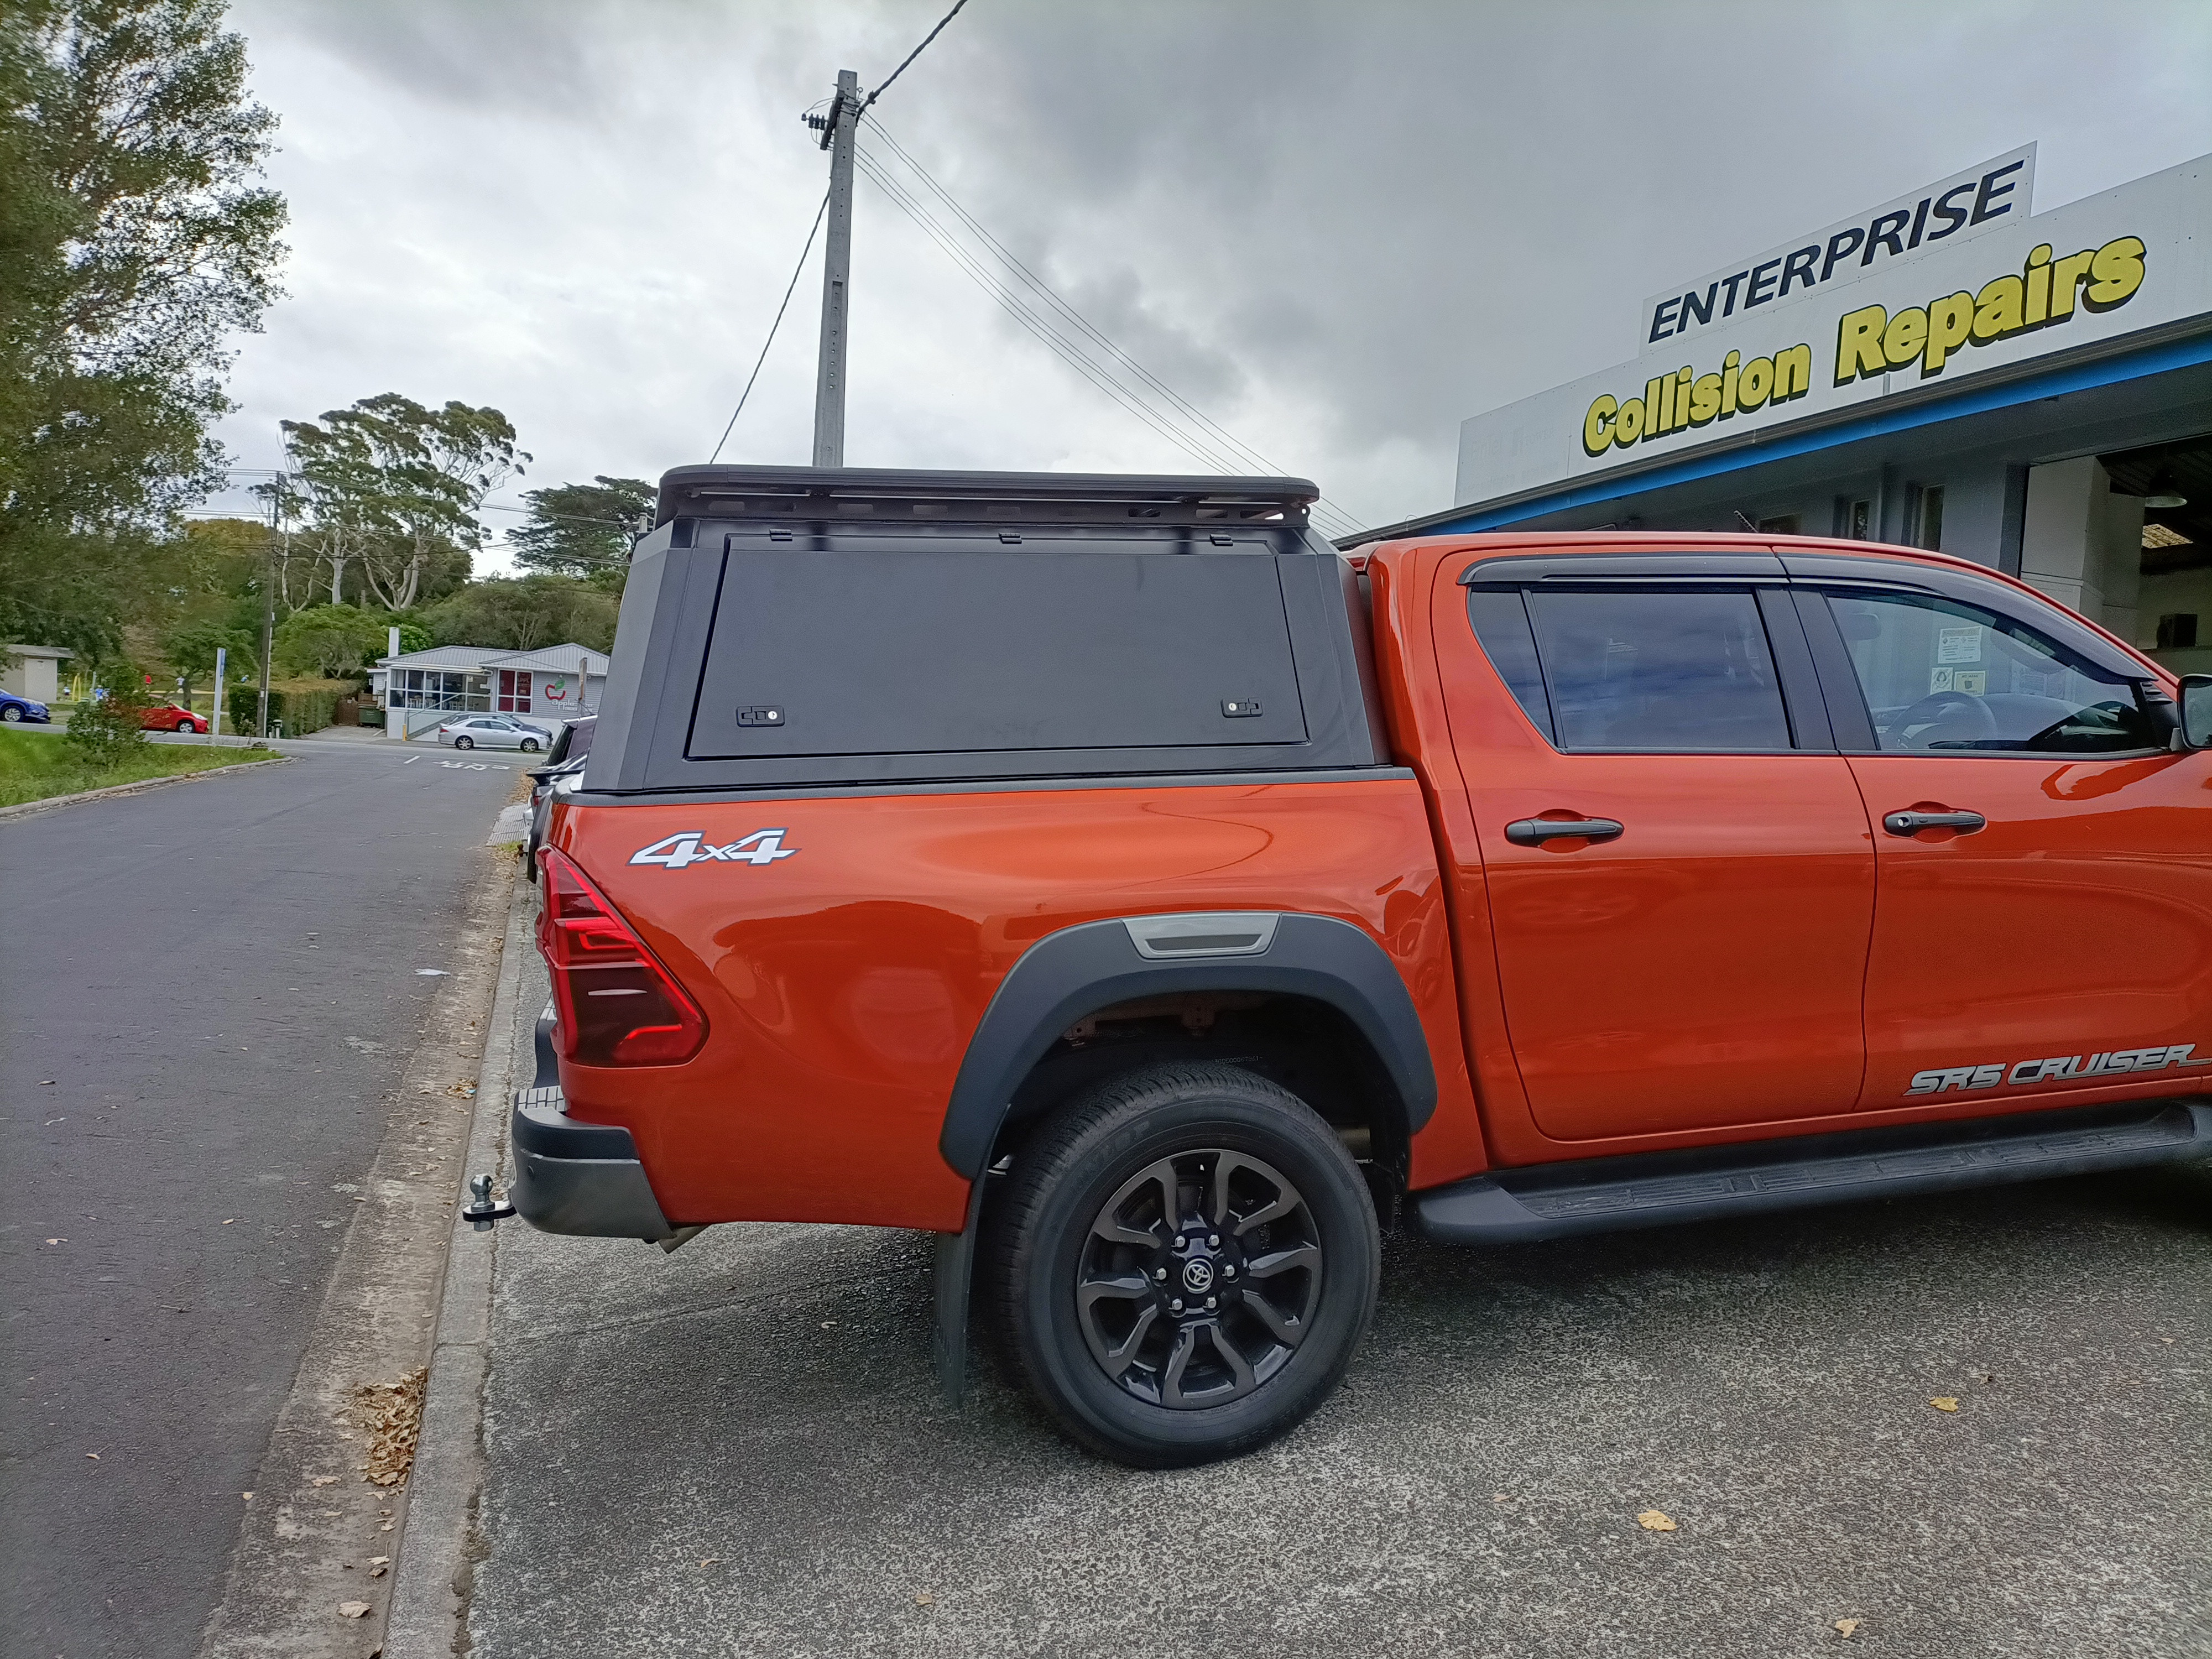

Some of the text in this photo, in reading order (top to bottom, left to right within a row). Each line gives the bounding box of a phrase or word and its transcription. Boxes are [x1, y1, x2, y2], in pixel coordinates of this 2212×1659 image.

[1648, 159, 2025, 343] ENTERPRISE
[1583, 236, 2146, 457] Collision Repairs
[1903, 1043, 2211, 1096] SR5 CRUISER
